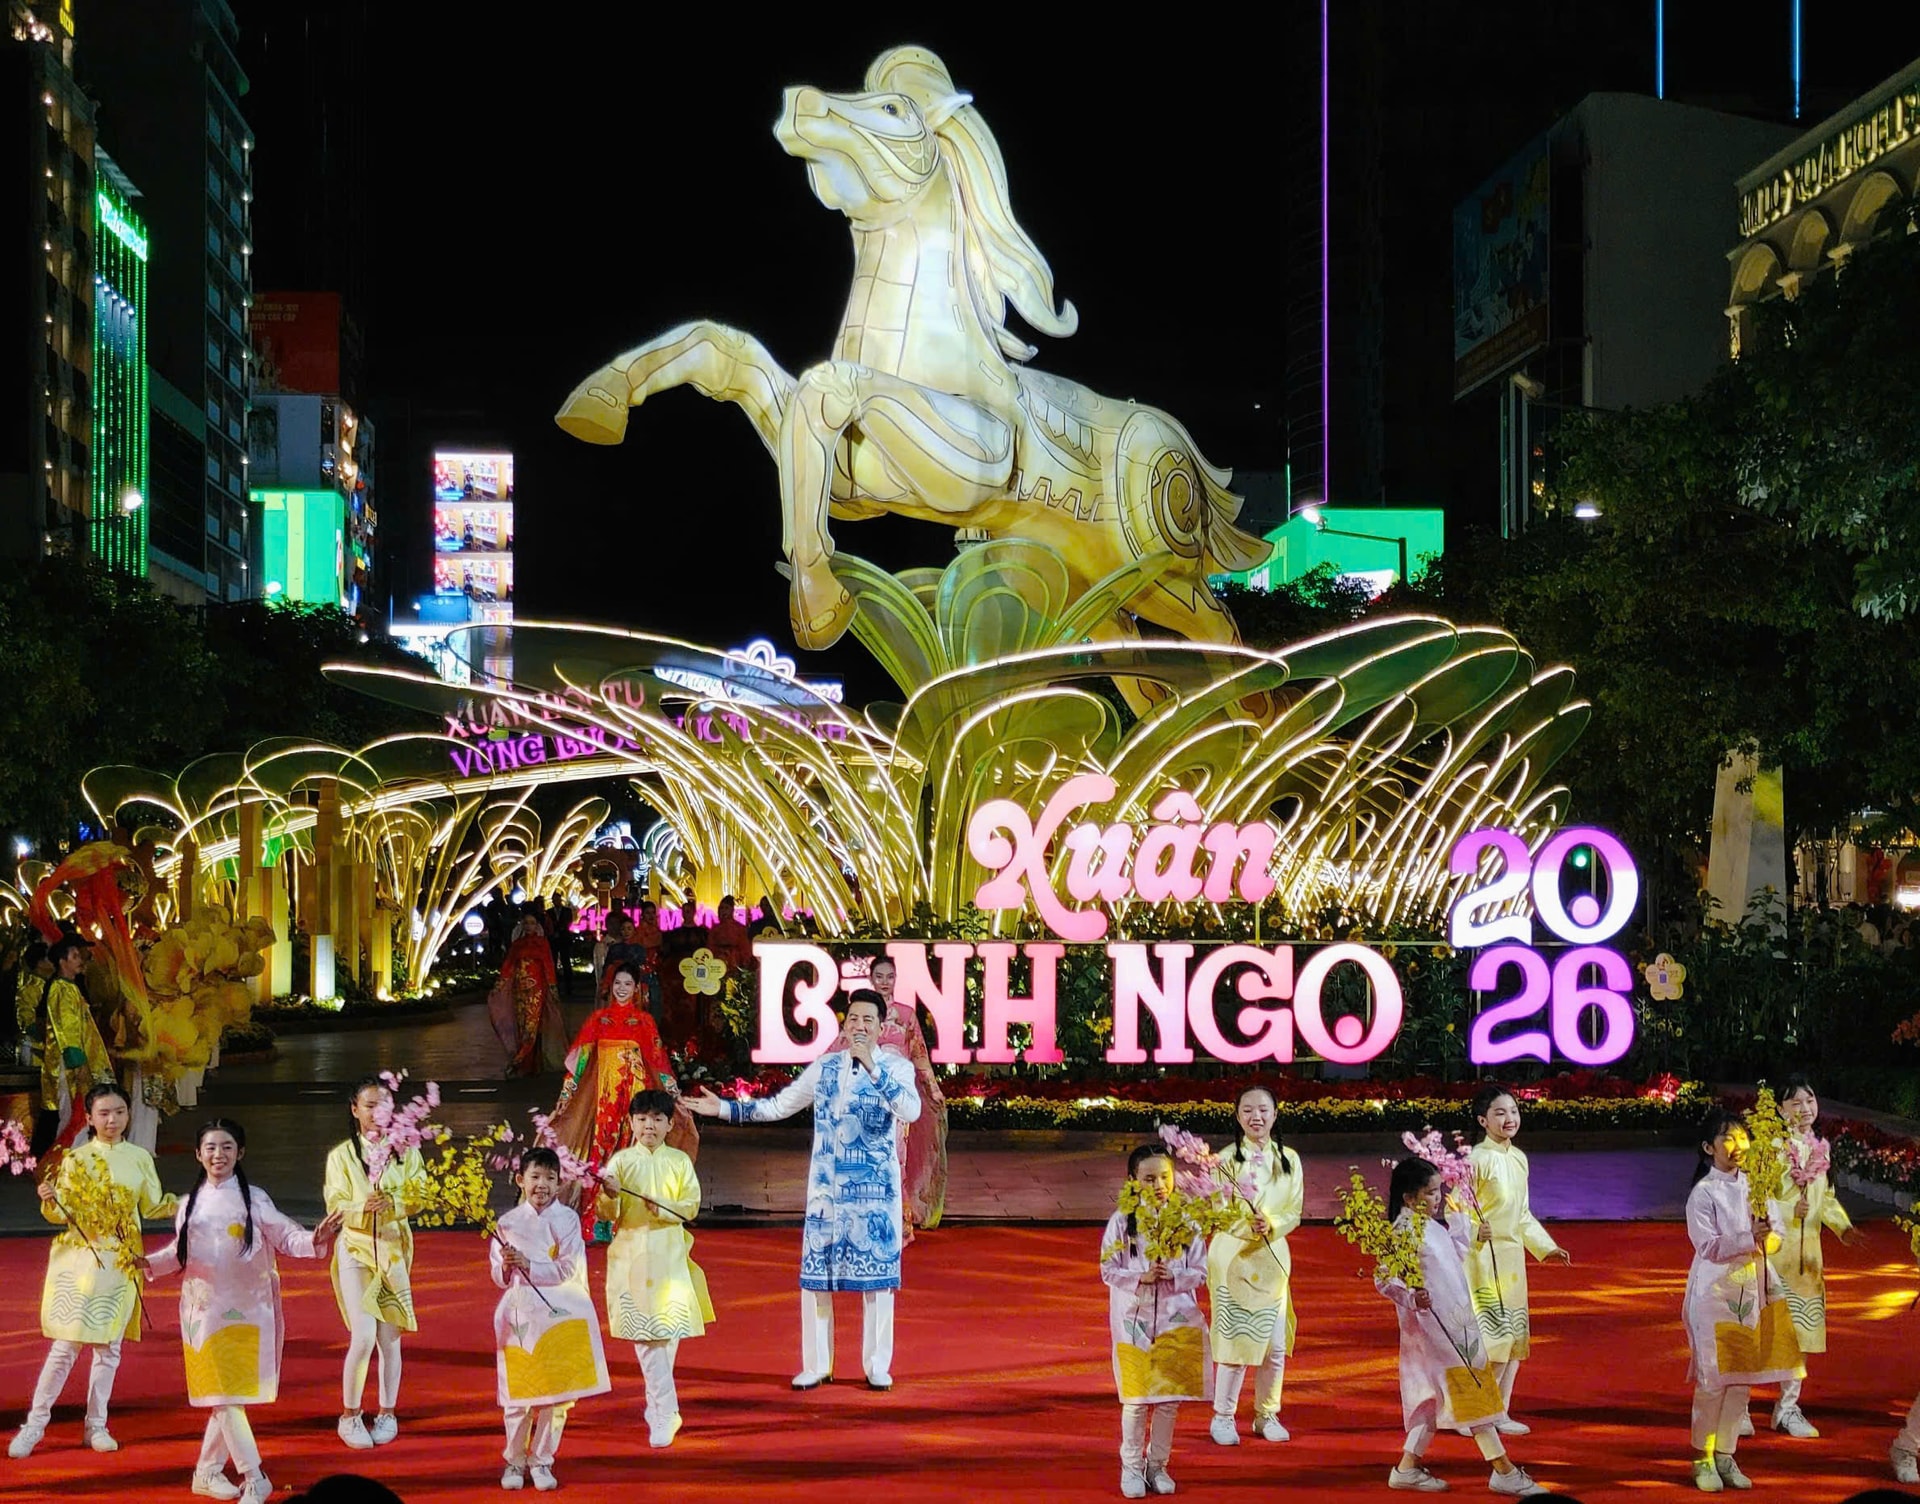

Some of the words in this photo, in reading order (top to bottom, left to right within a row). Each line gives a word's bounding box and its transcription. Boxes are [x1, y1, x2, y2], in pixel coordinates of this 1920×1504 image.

[968, 773, 1276, 941] Xuân
[1451, 828, 1639, 947] 20
[751, 942, 1066, 1064] BNH
[1470, 945, 1634, 1065] 26
